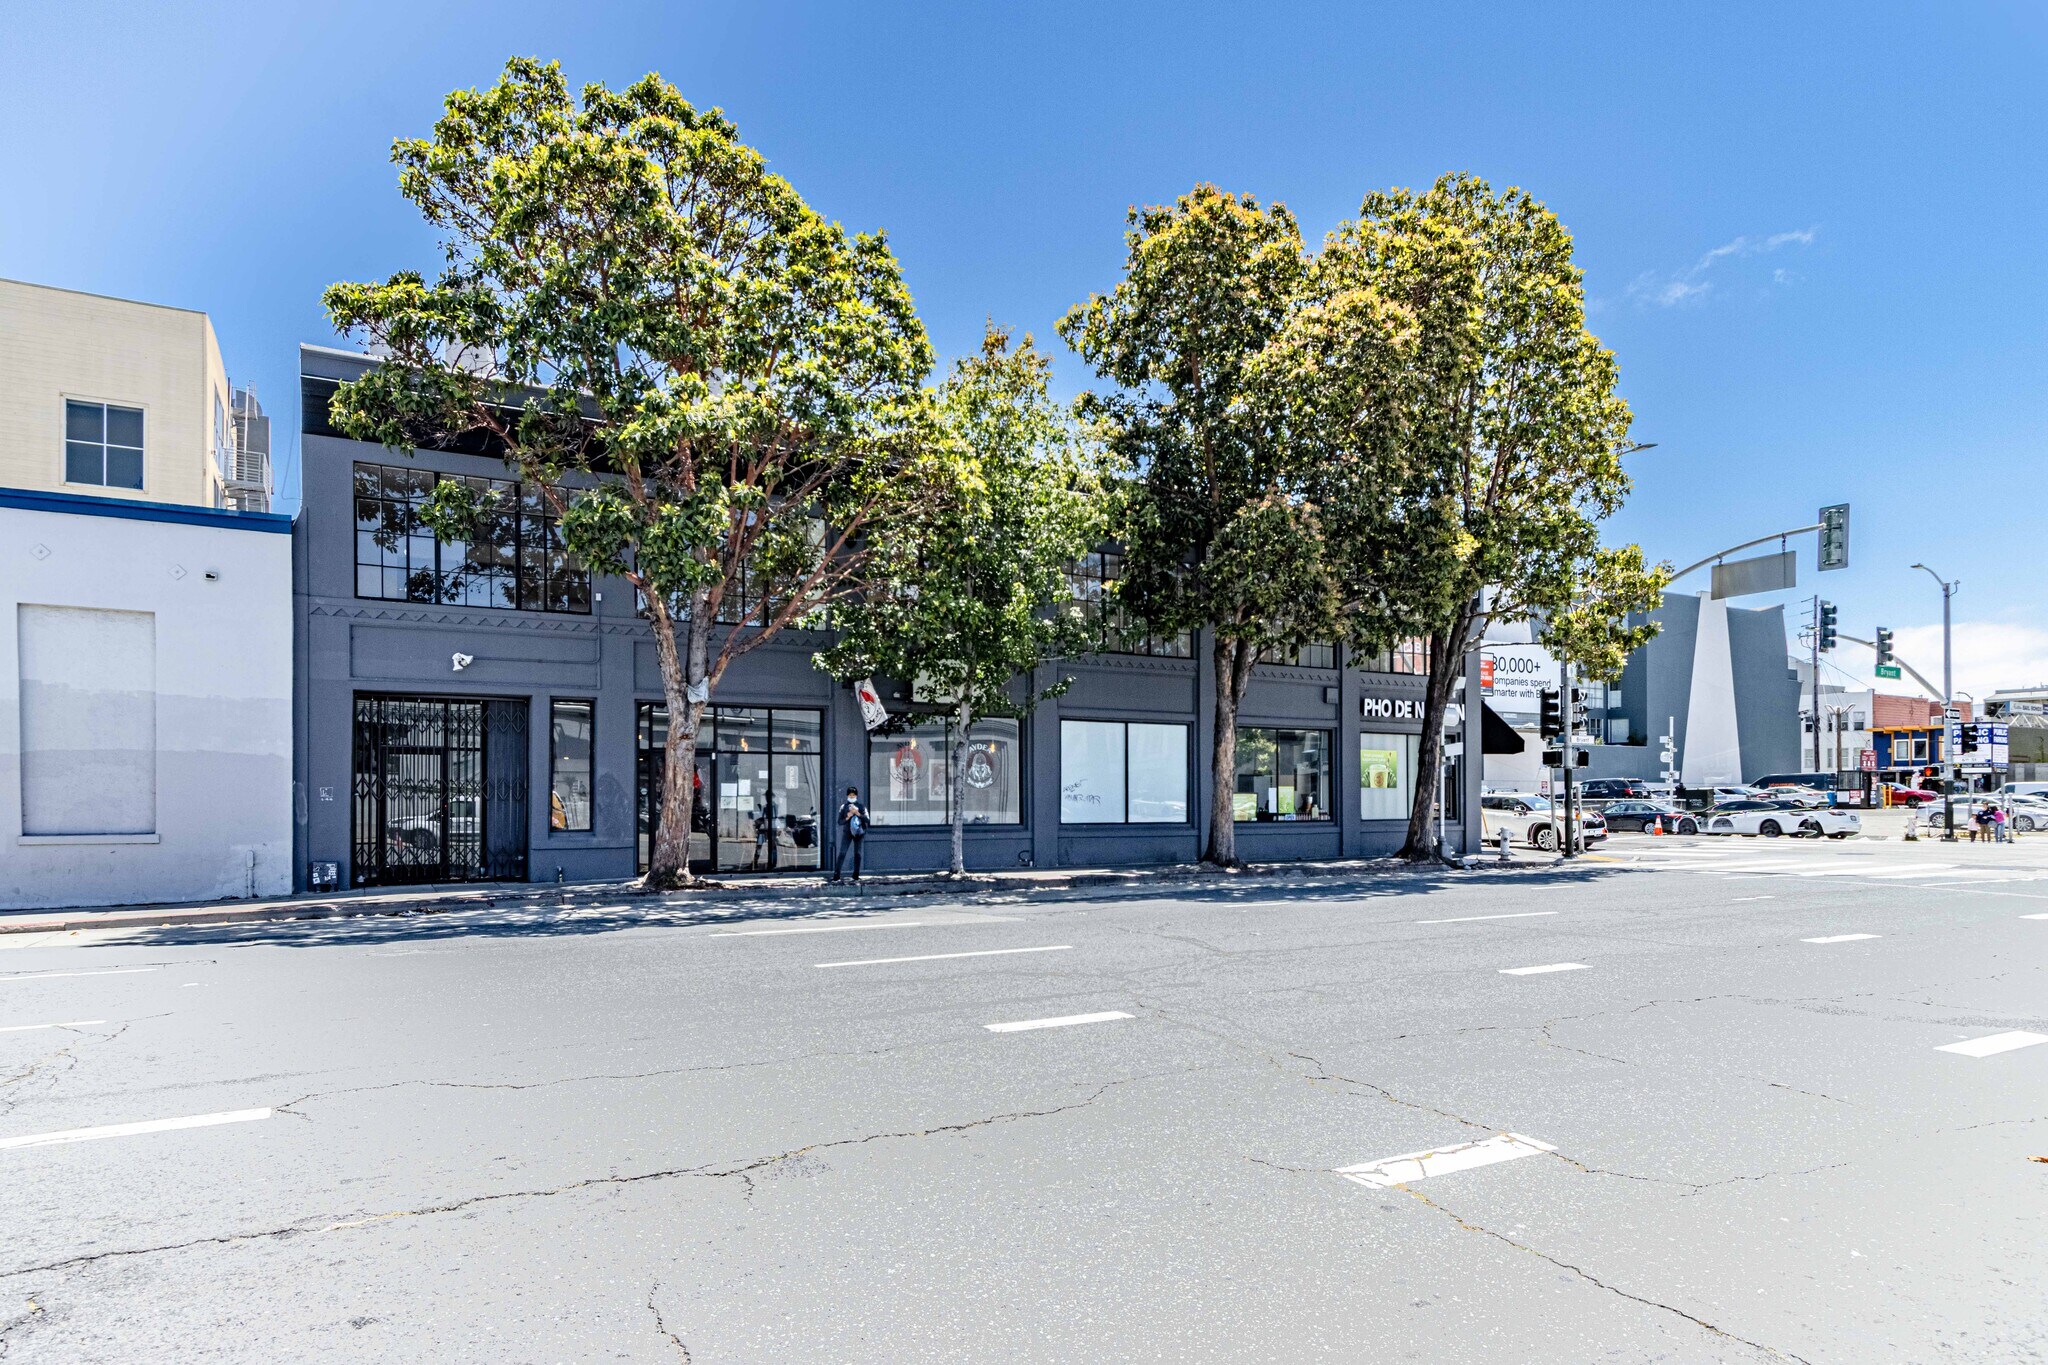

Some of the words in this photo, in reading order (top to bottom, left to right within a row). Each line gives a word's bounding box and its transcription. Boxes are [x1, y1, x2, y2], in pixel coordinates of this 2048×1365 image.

[1880, 667, 1896, 677] Bryant
[1494, 677, 1529, 687] ompanies
[1530, 679, 1552, 688] spend
[1494, 689, 1518, 697] marter
[1519, 690, 1535, 698] with
[1364, 698, 1392, 718] PHO
[1395, 700, 1412, 719] DE
[1953, 728, 1989, 737] PIC
[1993, 728, 2008, 736] PUBLIC
